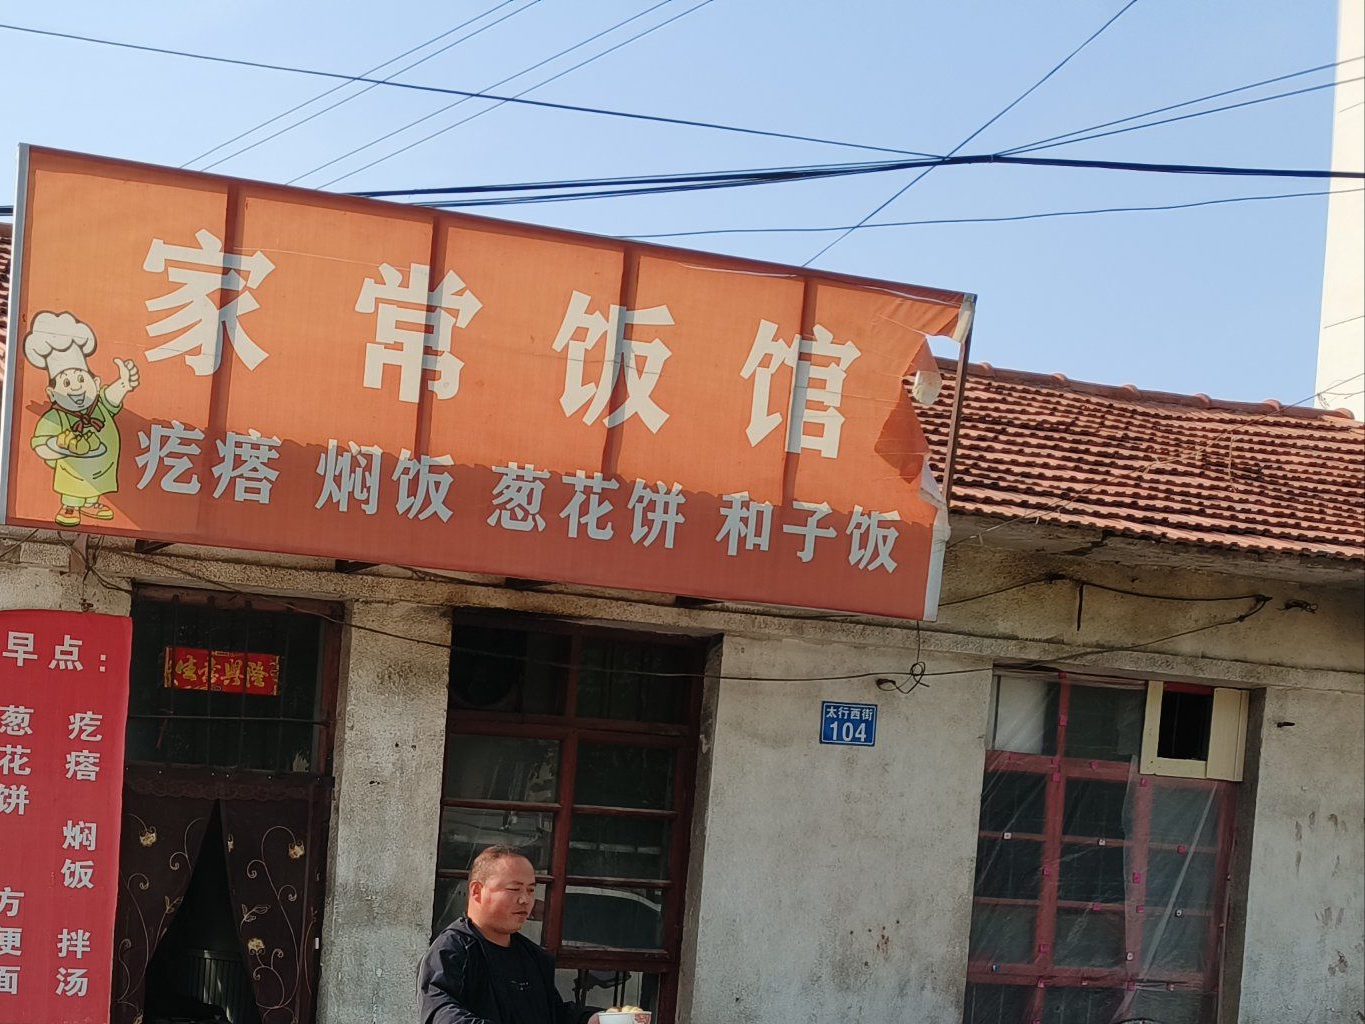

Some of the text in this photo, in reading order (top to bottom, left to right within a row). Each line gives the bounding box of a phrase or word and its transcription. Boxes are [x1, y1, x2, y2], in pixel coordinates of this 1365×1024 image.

[142, 229, 861, 459] 家常饭馆
[134, 420, 901, 573] 疙瘩 焖饭 葱花饼 和子饭
[2, 631, 107, 672] 早点：
[826, 706, 874, 721] 太行西街
[829, 721, 867, 742] 104
[55, 711, 103, 997] 疙瘩 焖饭 拌汤
